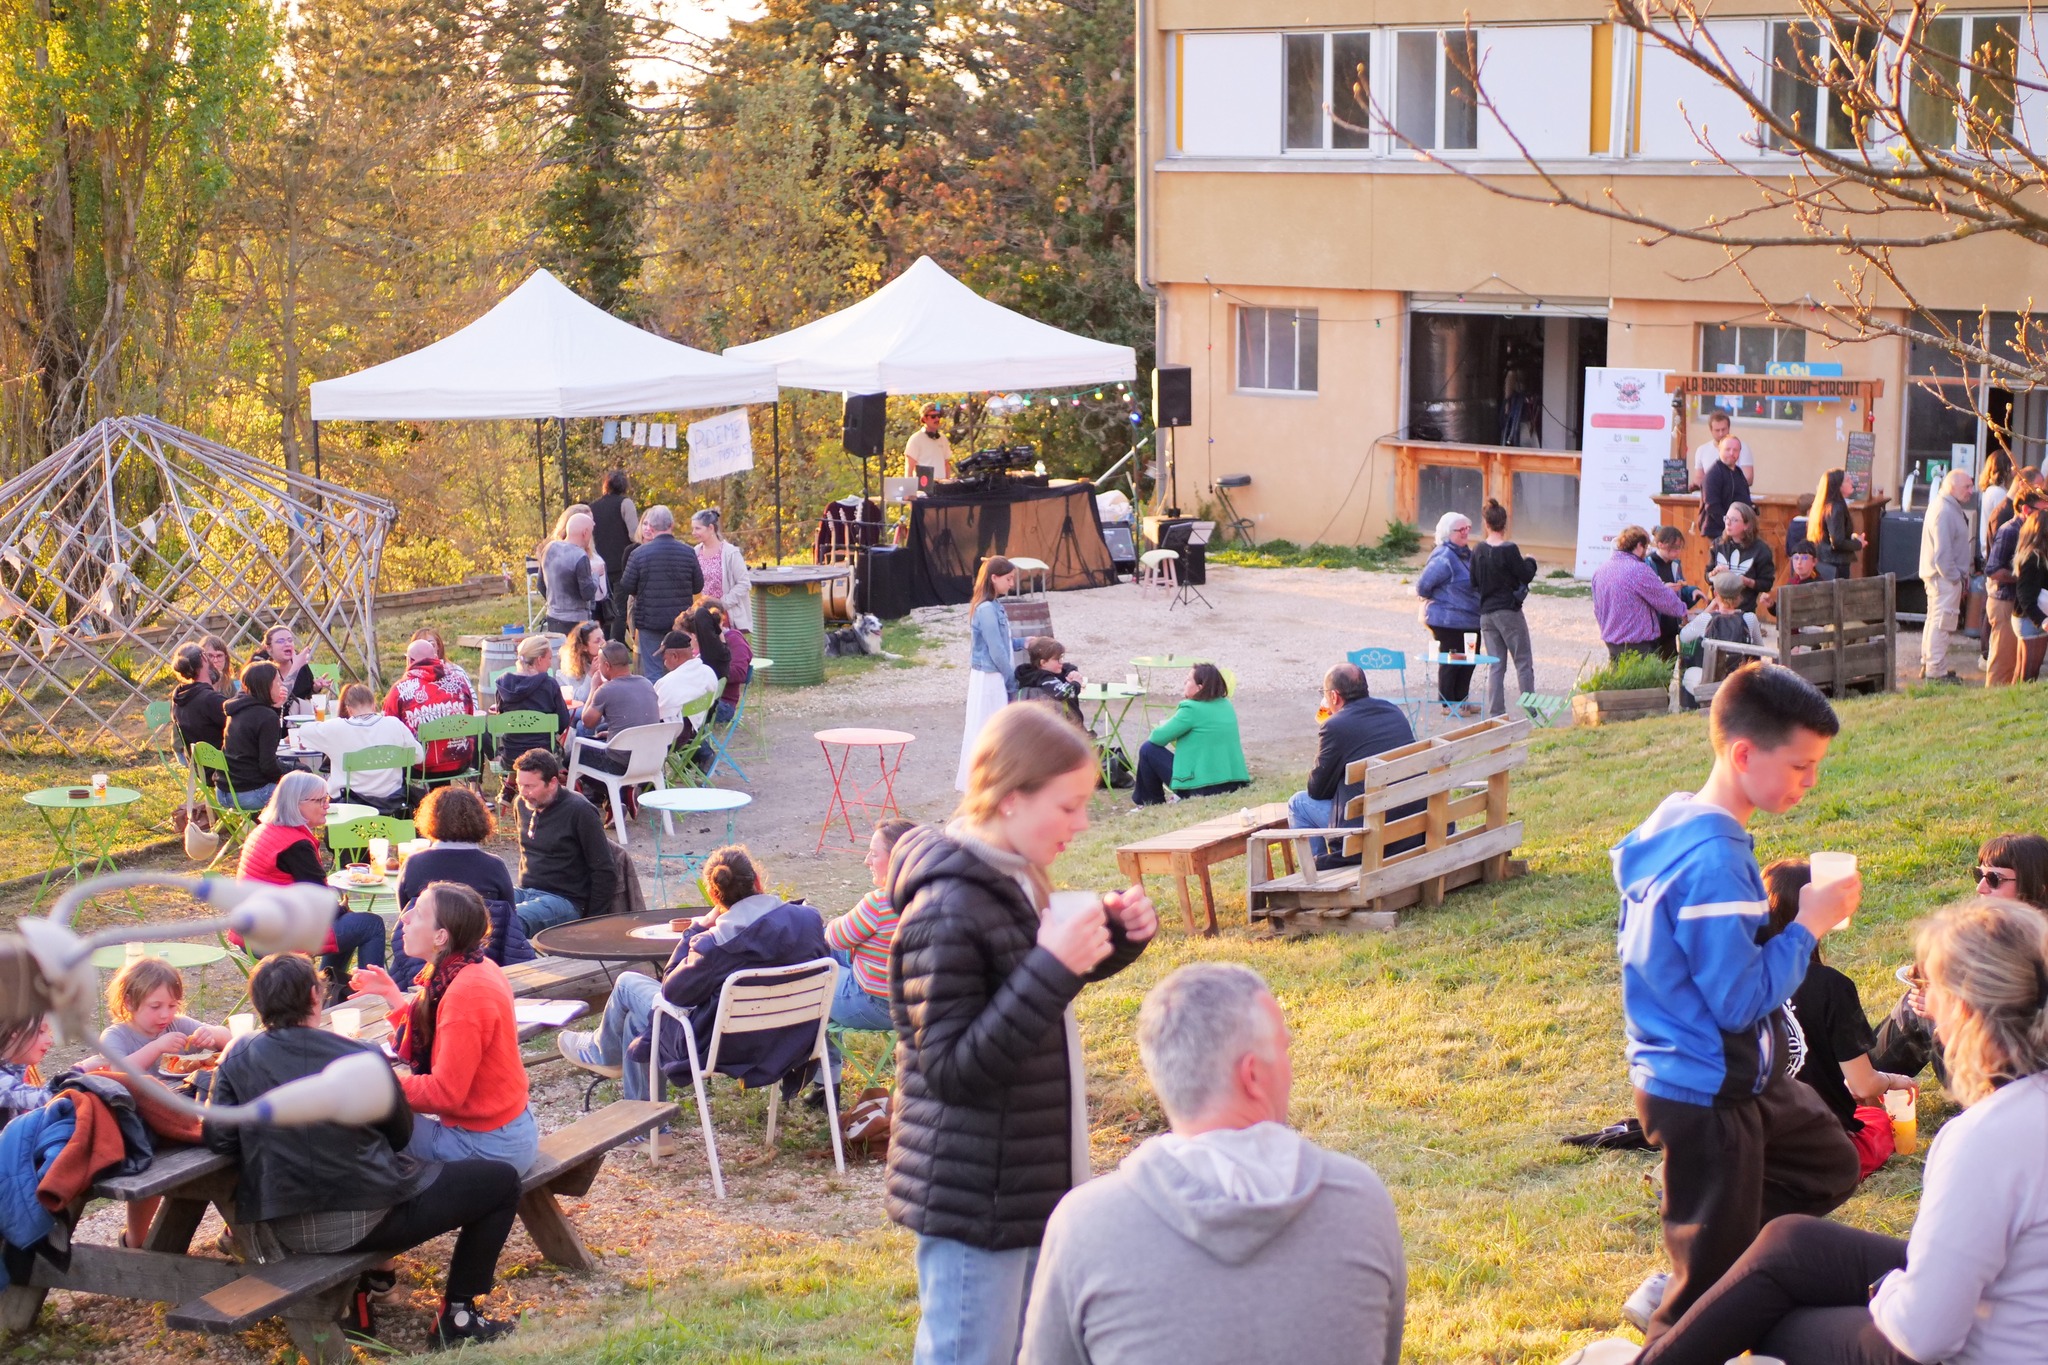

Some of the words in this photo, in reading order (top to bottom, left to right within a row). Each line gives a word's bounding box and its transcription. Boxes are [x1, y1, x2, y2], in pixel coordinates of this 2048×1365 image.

[1685, 376, 1698, 392] LA
[1701, 377, 1758, 393] BRASSERIE
[1761, 379, 1775, 394] DU
[1778, 380, 1860, 396] COURT-CIRCUIT
